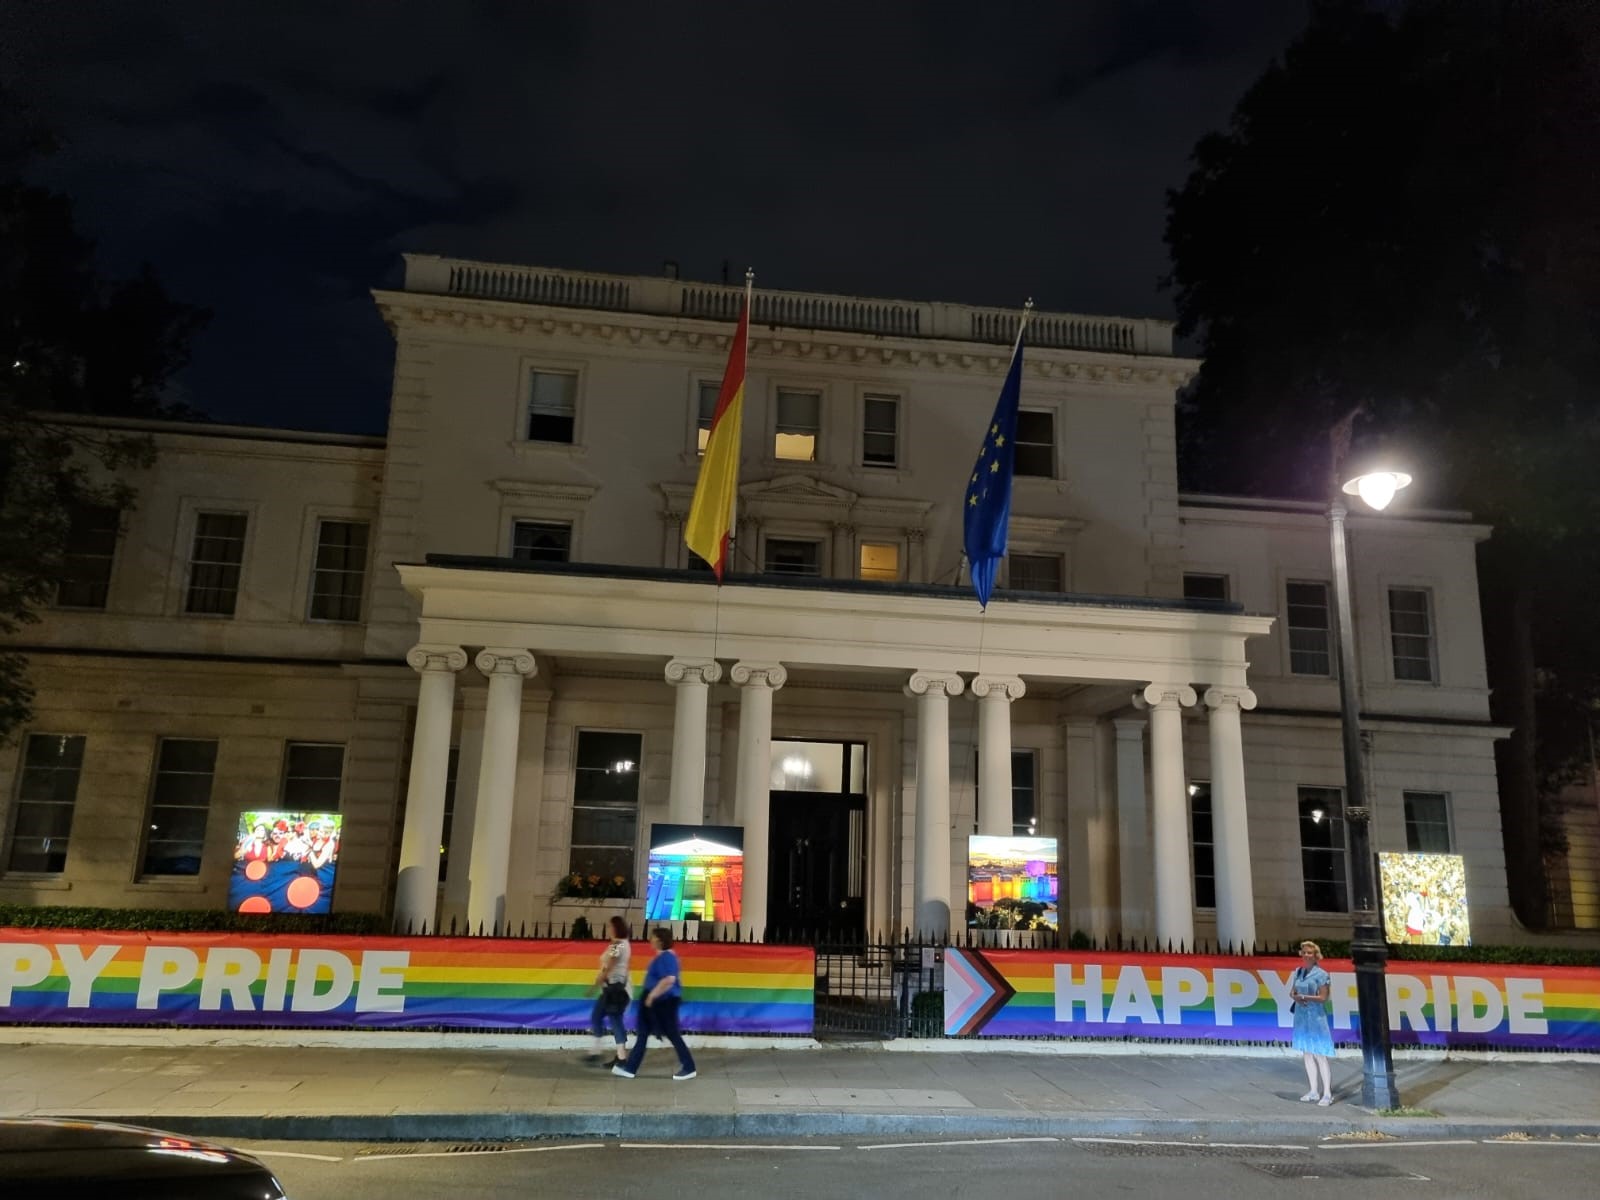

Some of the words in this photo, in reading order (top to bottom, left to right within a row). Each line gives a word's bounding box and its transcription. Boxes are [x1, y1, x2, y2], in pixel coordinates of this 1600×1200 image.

[0, 943, 122, 1008] PY
[136, 945, 411, 1013] PRIDE
[1054, 963, 1295, 1028] HAPPY
[1329, 972, 1548, 1034] PRIDE
